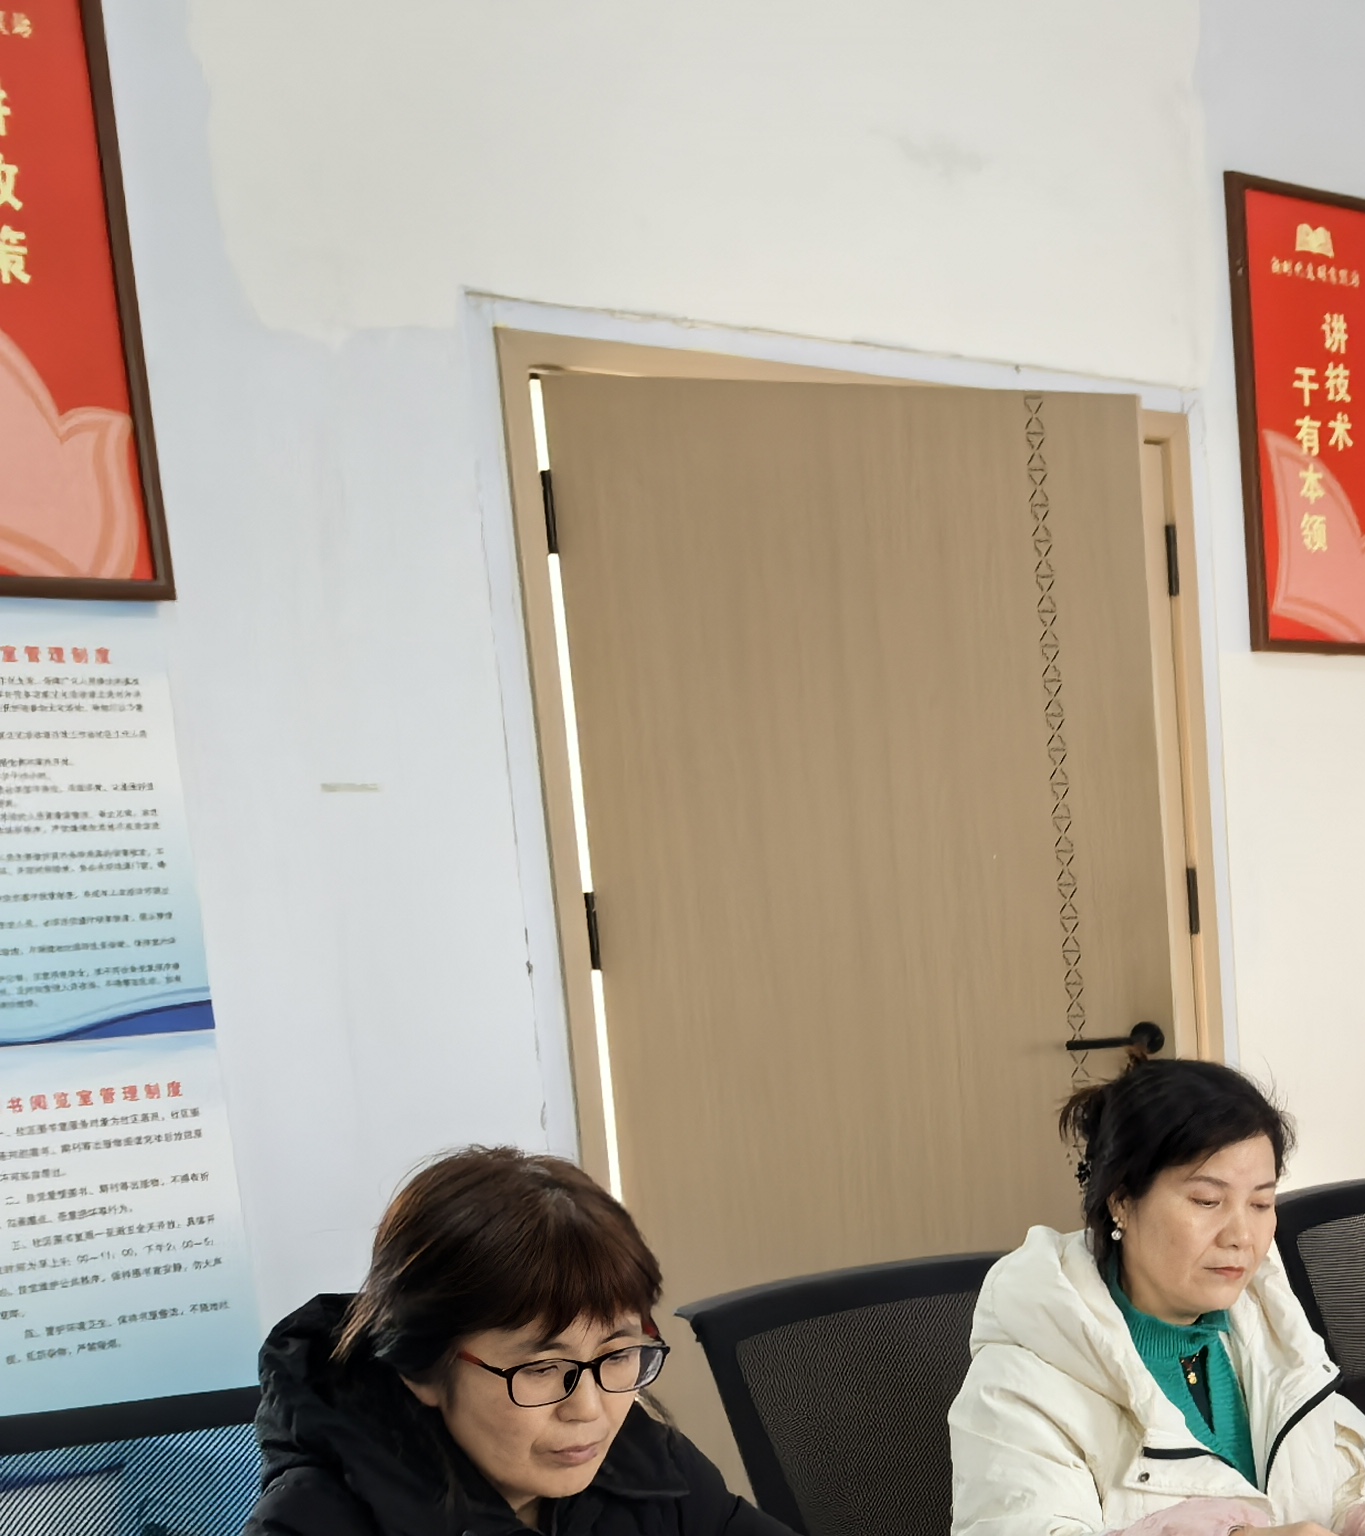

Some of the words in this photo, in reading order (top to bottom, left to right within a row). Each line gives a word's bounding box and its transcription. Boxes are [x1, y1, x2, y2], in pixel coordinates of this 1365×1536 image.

[1292, 366, 1328, 554] 干有本领
[1322, 312, 1353, 452] 讲技术
